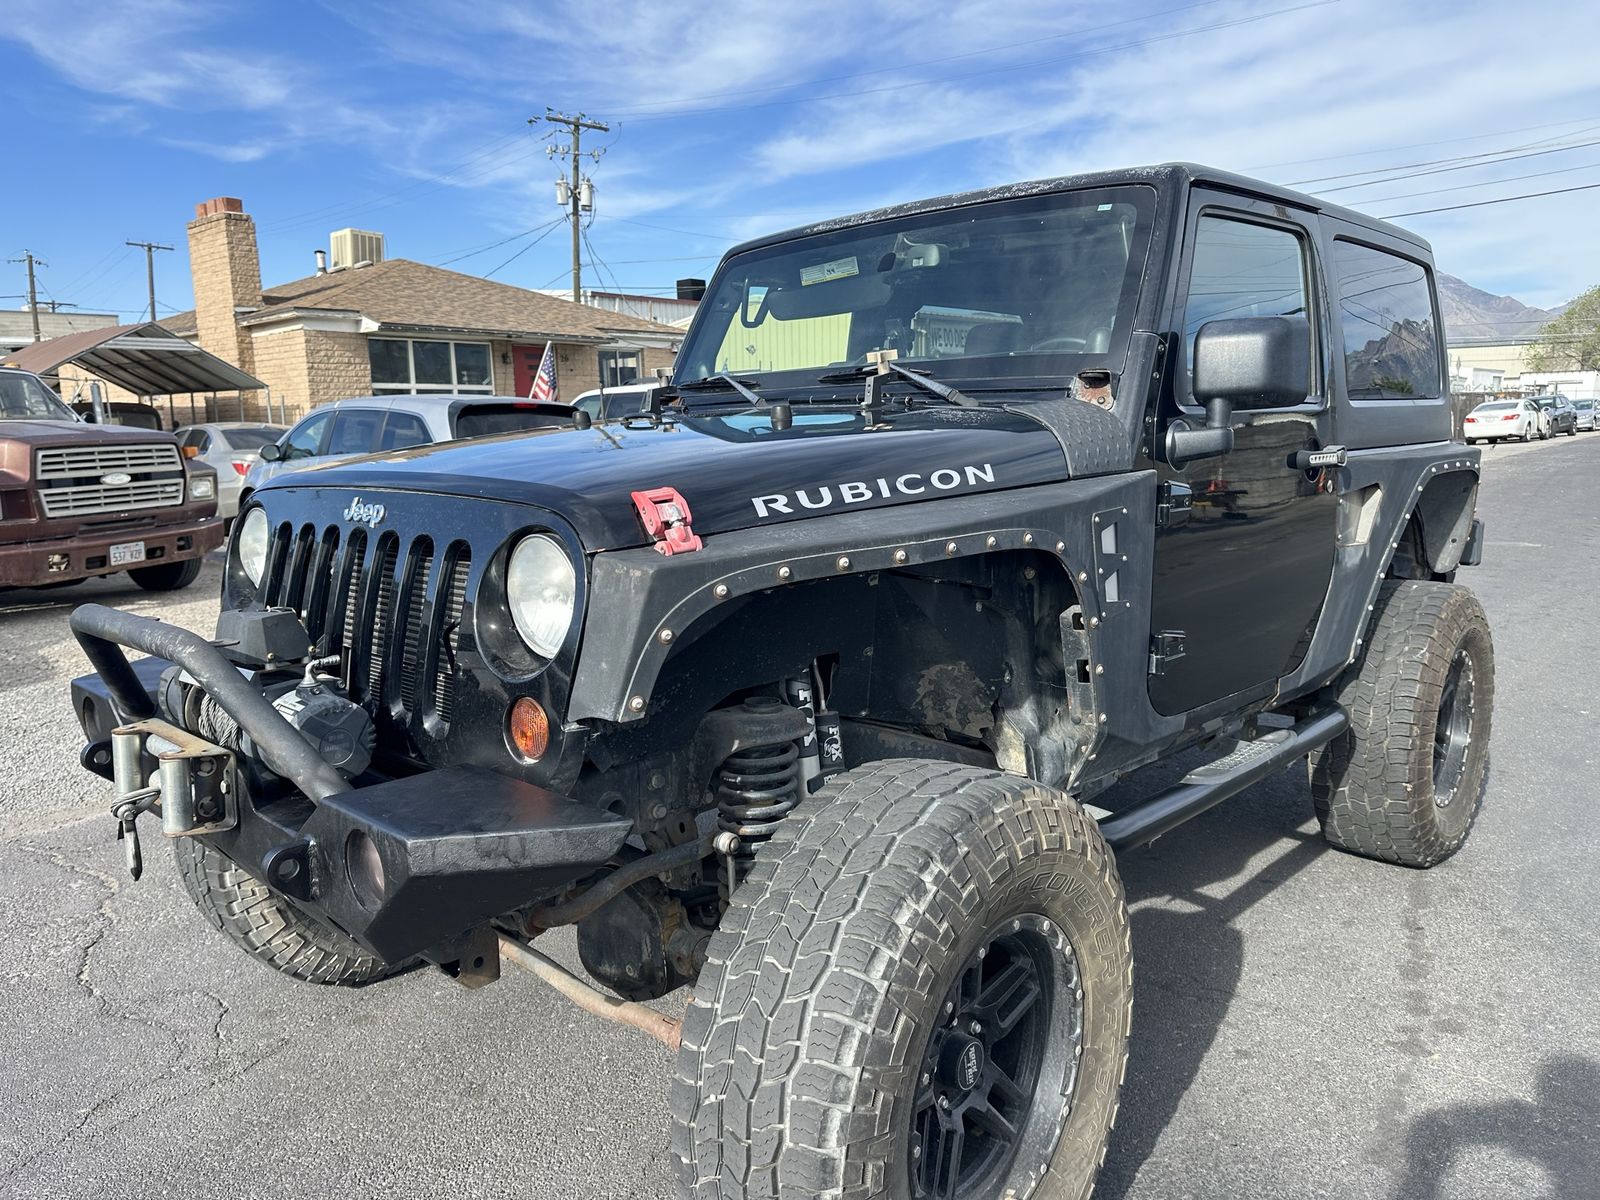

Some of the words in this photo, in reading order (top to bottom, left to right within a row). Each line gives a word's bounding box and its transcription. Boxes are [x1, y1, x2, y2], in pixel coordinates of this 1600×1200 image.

[343, 496, 385, 528] Jeep
[751, 463, 995, 518] RUBICON
[824, 726, 843, 761] FOX
[984, 871, 1117, 981] DISCOVERER
